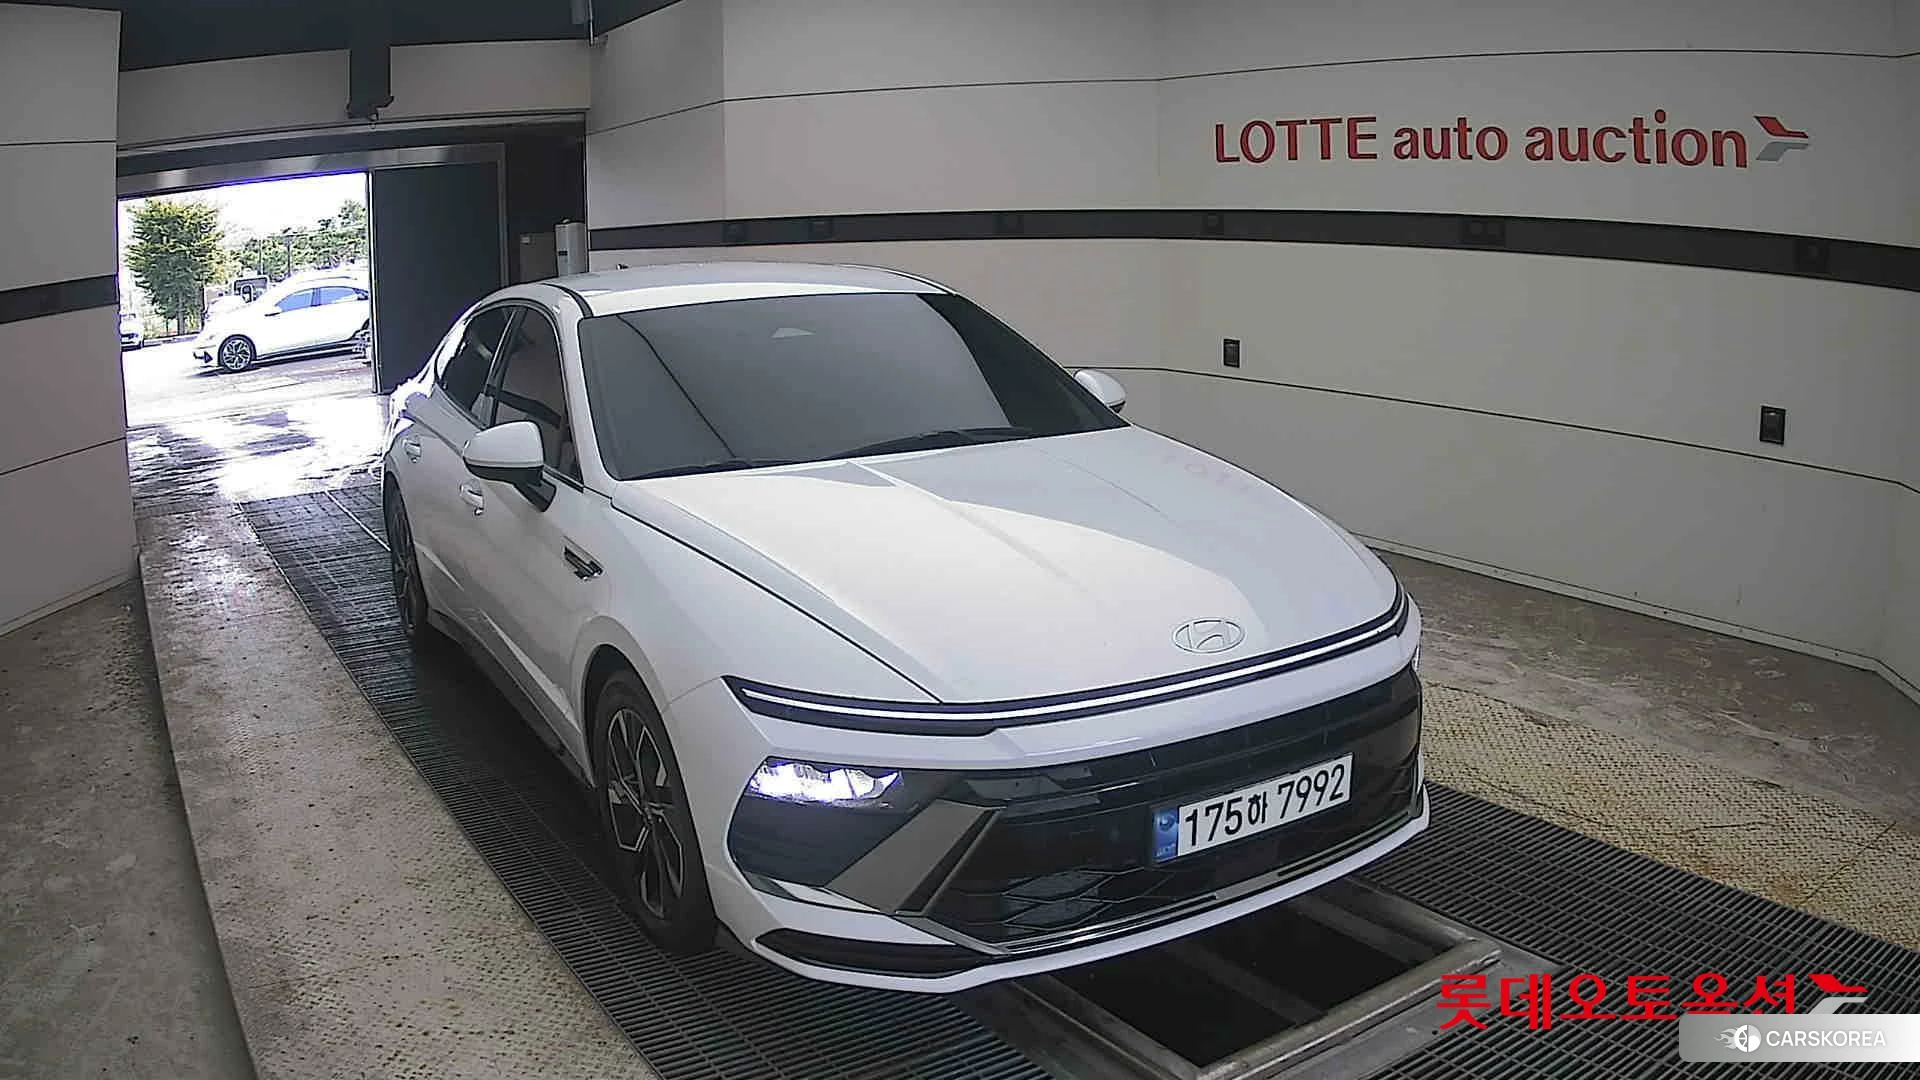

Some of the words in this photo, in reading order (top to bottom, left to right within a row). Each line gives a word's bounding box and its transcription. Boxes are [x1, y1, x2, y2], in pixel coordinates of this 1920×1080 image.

[1214, 116, 1377, 163] LOTTE
[1393, 116, 1508, 161] auto
[1524, 109, 1748, 168] auction
[1184, 791, 1269, 846] 175하
[1277, 763, 1346, 820] 7992
